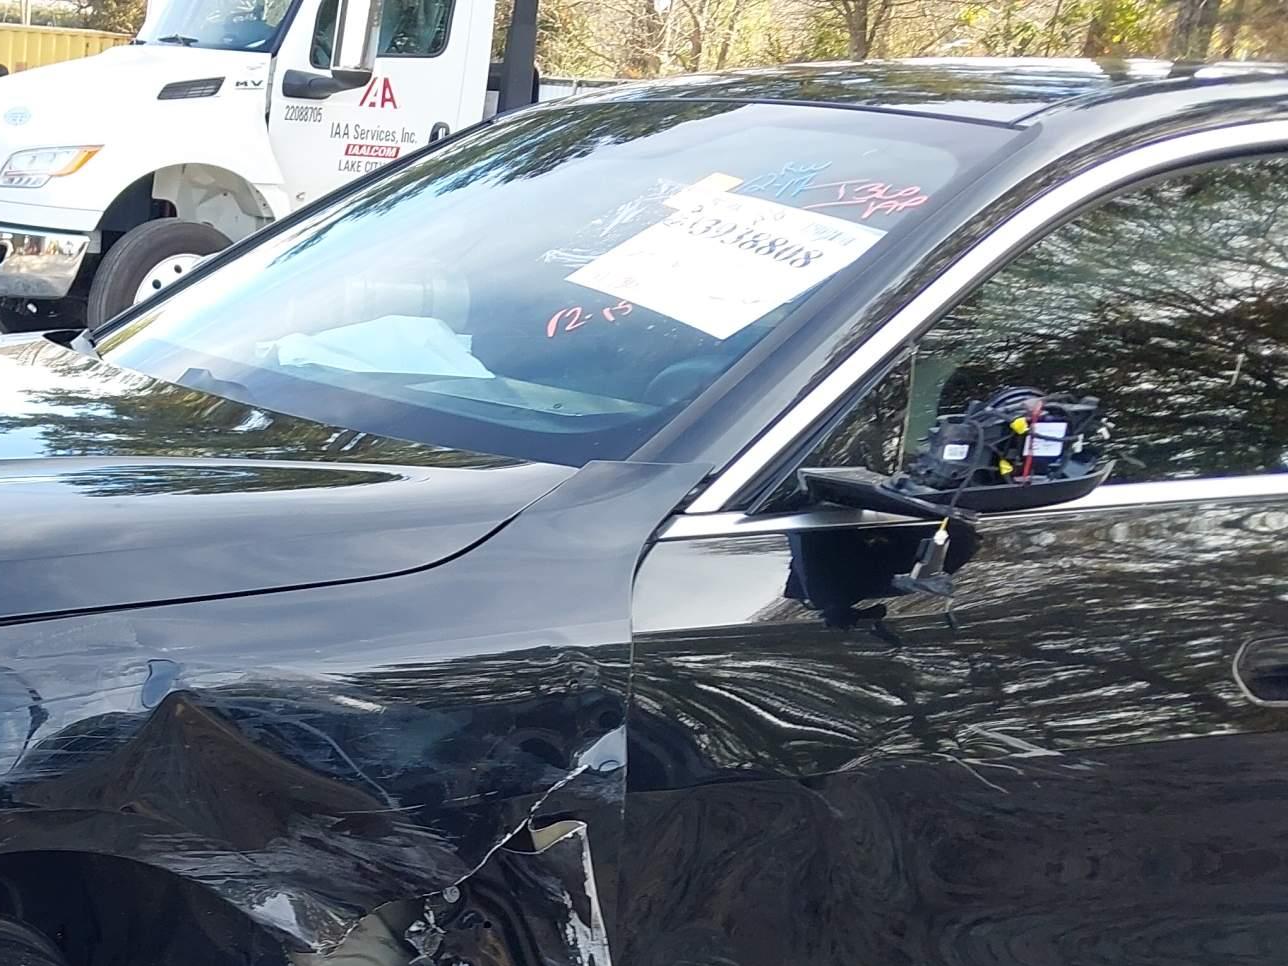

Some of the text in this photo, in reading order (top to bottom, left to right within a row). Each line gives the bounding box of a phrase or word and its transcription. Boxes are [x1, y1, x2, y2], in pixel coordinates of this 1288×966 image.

[235, 79, 263, 87] MV
[284, 105, 323, 123] 22088705
[330, 122, 418, 145] IAA Services, Inc.
[338, 159, 362, 173] LAKE
